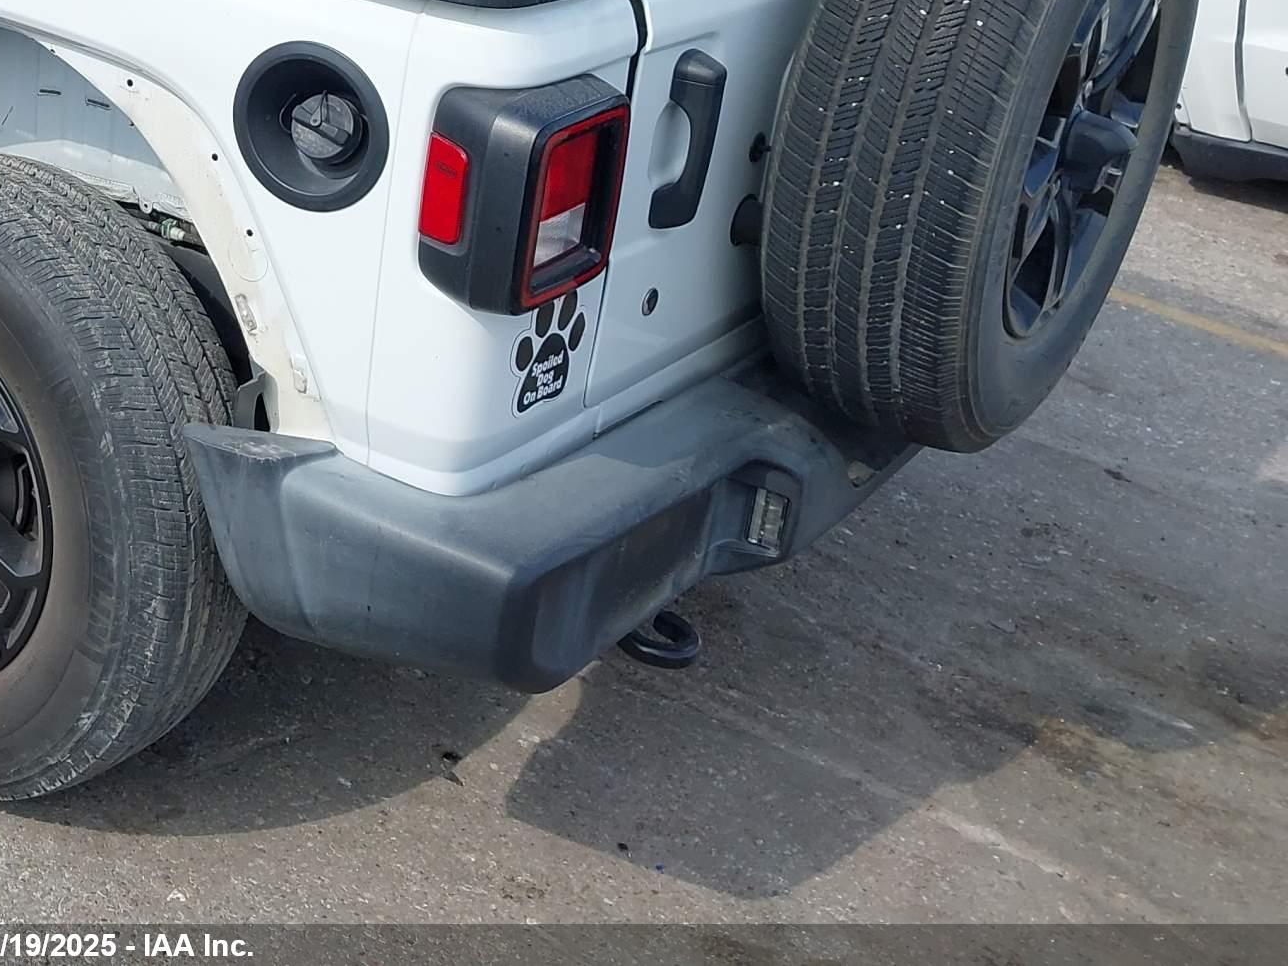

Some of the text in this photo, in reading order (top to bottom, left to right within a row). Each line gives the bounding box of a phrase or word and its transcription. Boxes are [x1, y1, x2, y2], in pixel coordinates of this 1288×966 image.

[531, 350, 565, 377] Spoiled
[523, 376, 563, 405] On Board
[536, 371, 554, 388] Dog
